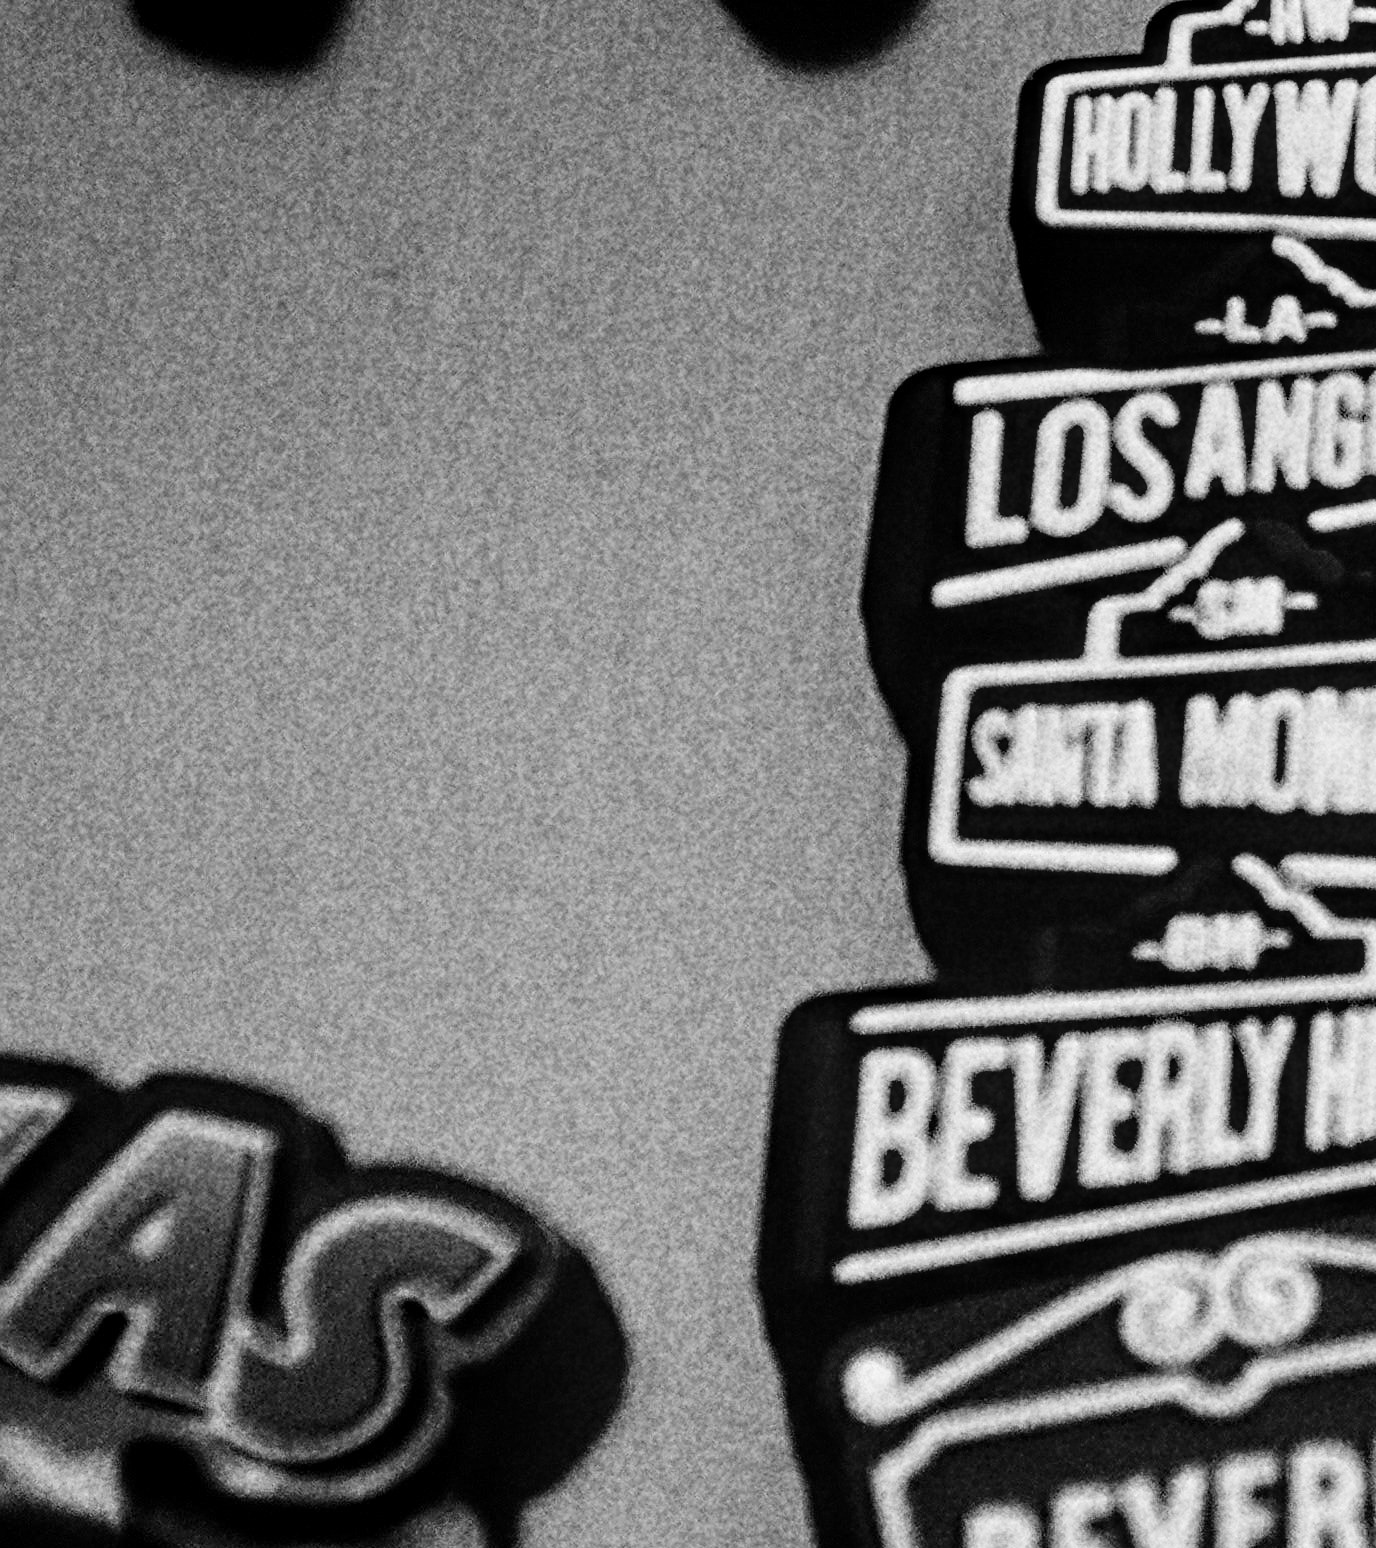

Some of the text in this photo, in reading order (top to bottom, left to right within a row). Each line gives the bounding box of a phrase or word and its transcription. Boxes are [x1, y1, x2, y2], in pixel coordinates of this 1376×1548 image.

[1224, 295, 1308, 344] LA
[965, 391, 1179, 550] LOS
[969, 698, 1158, 808] SANTA
[847, 1014, 1295, 1231] BEVERLY
